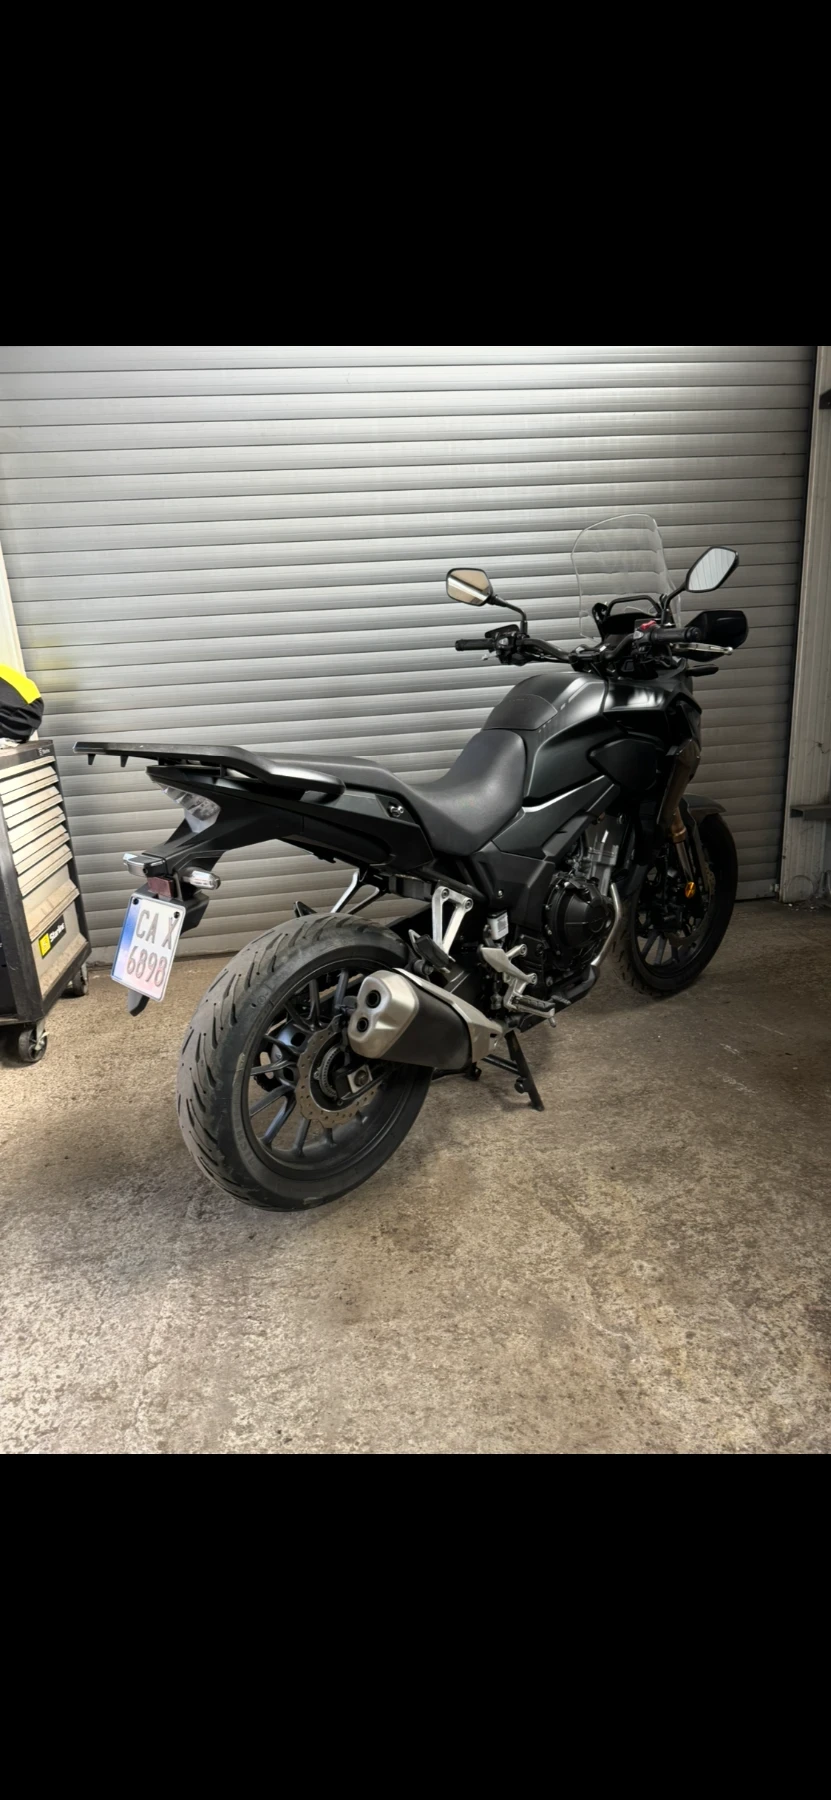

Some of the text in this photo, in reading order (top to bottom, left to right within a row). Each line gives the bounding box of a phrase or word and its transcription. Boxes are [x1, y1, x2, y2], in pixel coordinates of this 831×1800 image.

[135, 909, 179, 949] CA X
[126, 945, 167, 988] 6898
